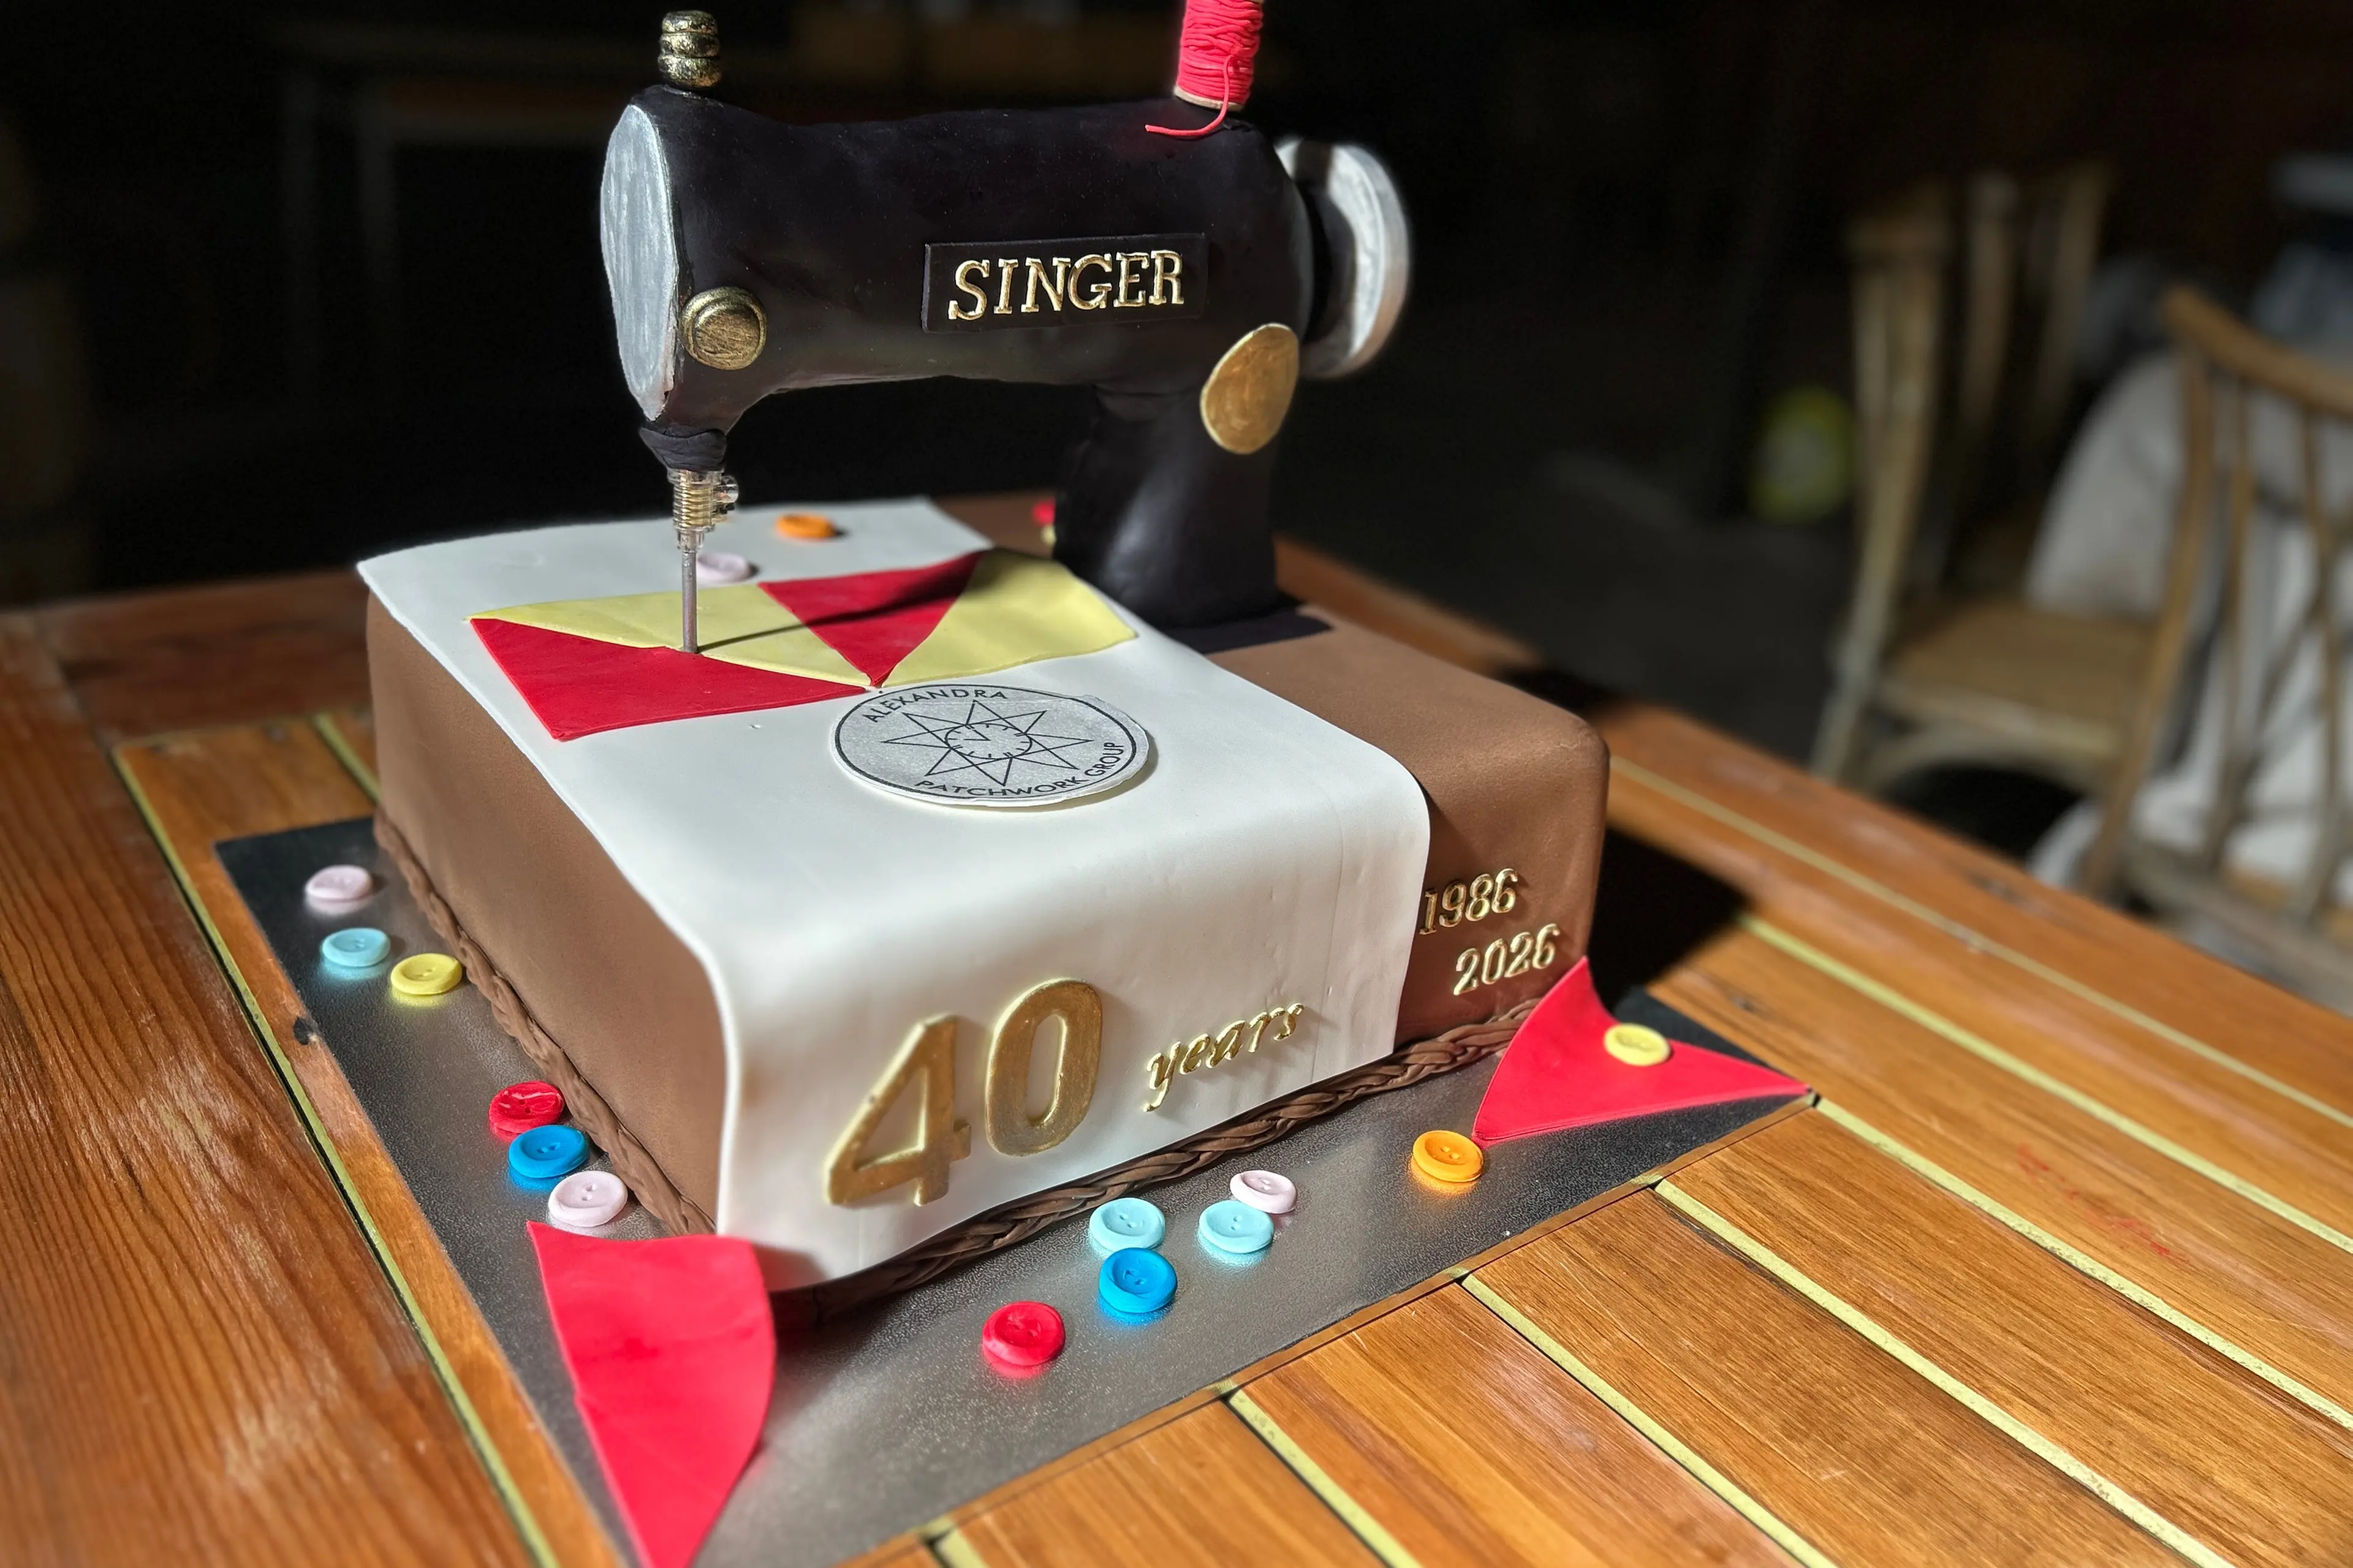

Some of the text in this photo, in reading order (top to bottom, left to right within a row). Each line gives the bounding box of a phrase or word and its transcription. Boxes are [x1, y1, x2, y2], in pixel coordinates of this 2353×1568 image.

[947, 249, 1184, 320] SINGER
[862, 688, 1009, 723] ALEXANDRA
[914, 741, 1125, 797] PATCHWORK GROUP
[1419, 868, 1518, 935] 1986
[1452, 923, 1561, 996] 2026
[823, 975, 1305, 1207] 40 years
